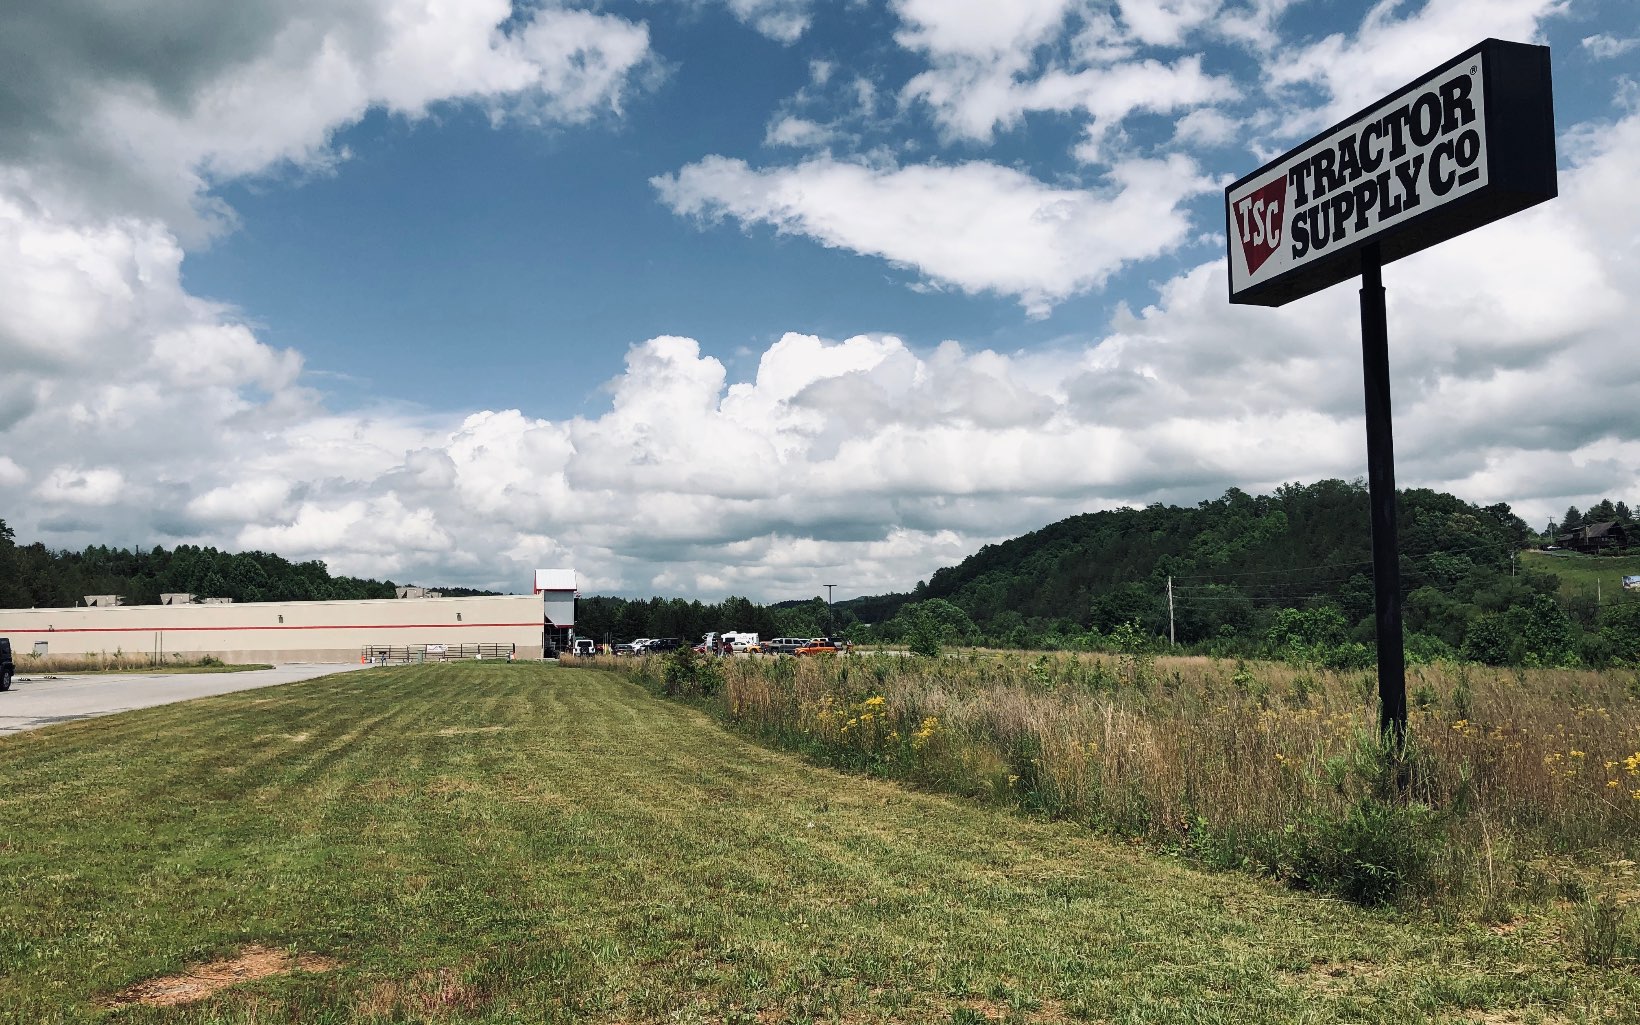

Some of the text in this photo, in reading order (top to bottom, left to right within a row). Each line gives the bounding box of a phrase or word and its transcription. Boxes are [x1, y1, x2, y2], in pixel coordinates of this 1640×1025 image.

[1288, 74, 1476, 209] TRACTOR
[1239, 197, 1279, 249] TSC
[1290, 152, 1424, 260] SUPPLY
